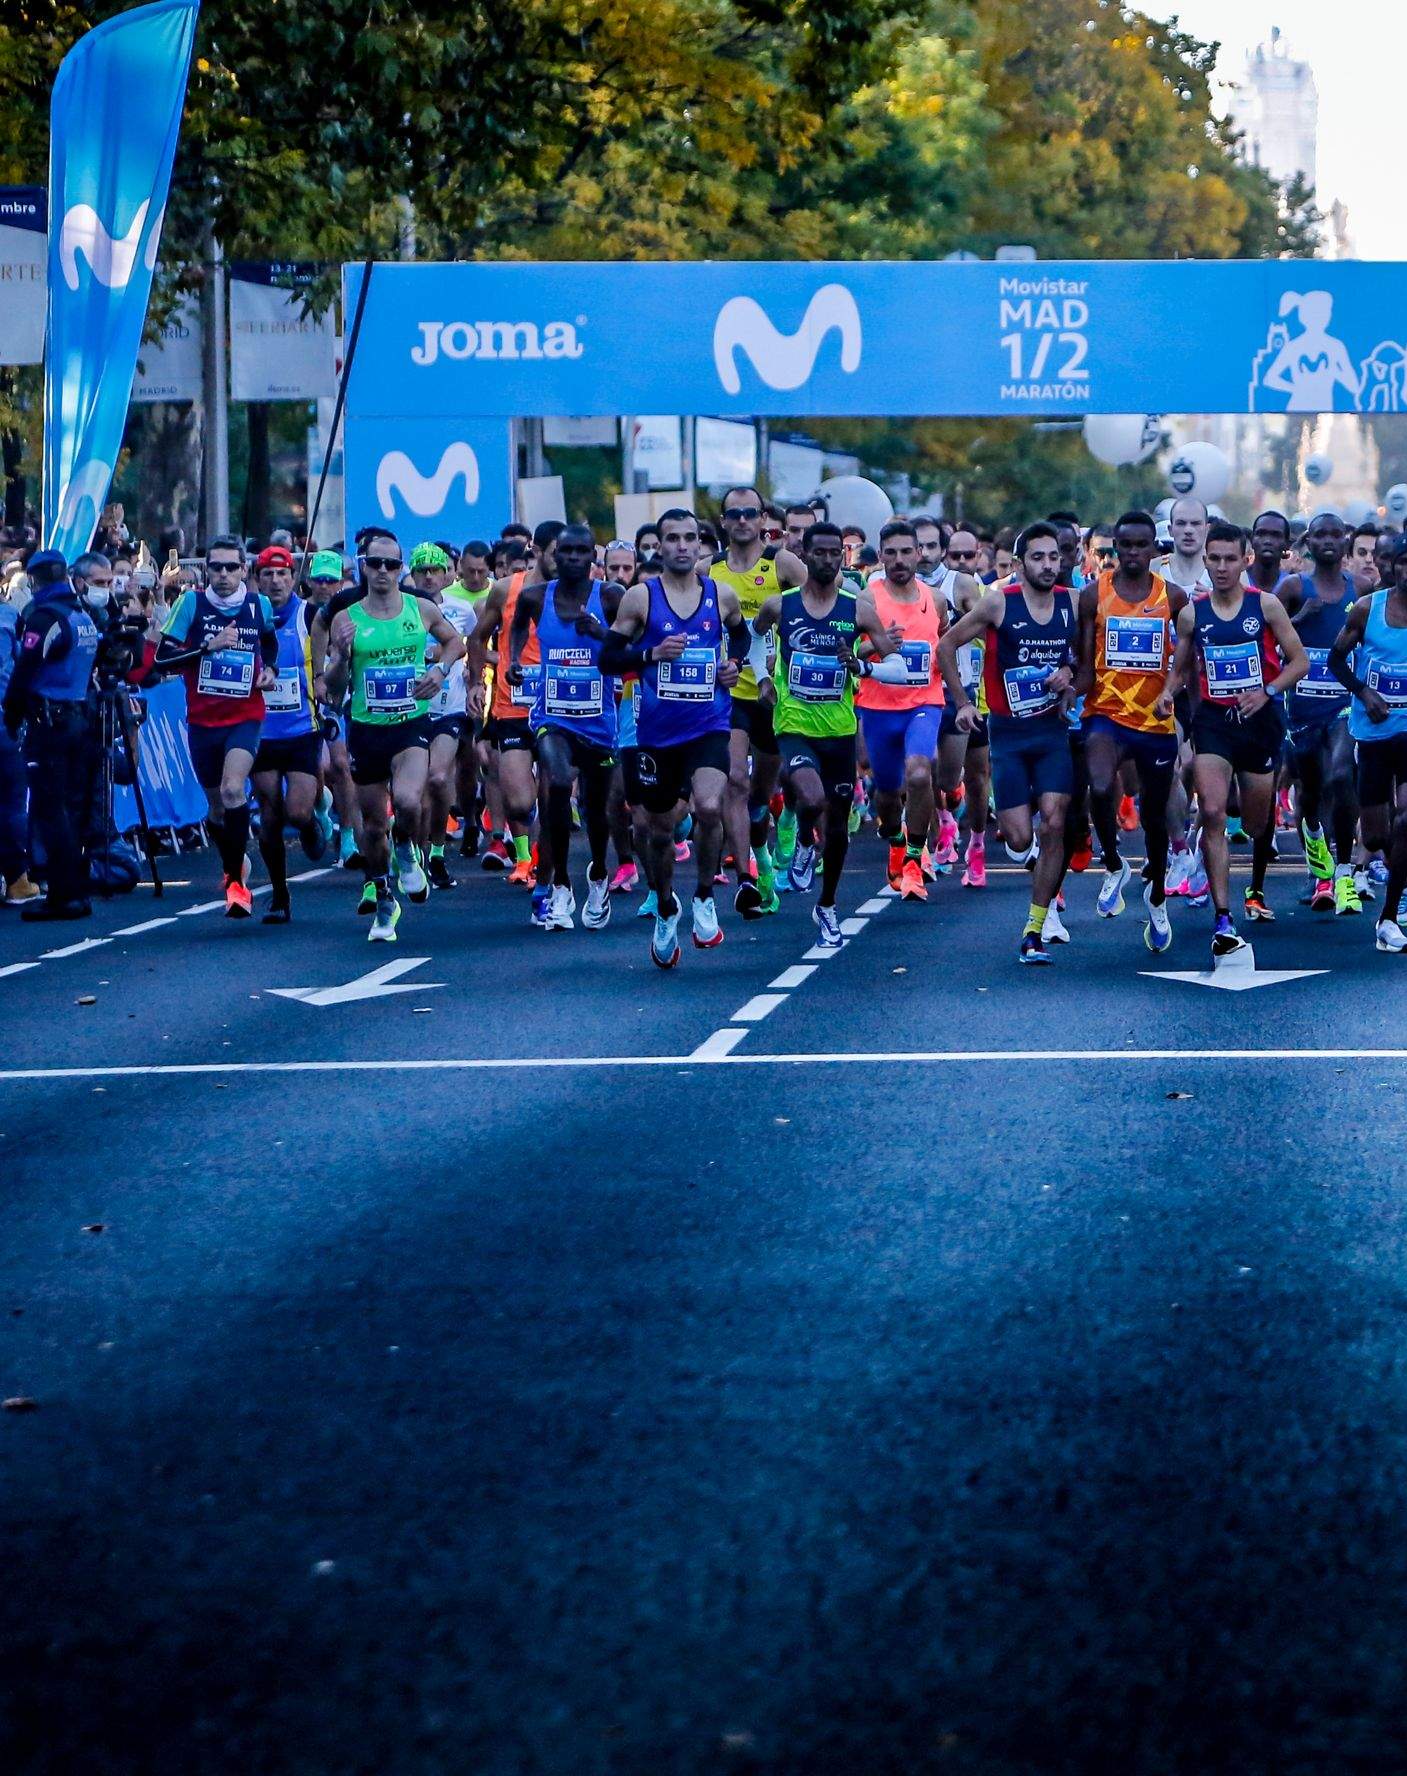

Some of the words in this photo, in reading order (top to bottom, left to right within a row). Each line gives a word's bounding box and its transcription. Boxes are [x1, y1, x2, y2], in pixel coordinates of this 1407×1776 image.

[1001, 278, 1087, 295] Movistar
[1001, 299, 1089, 329] MAD
[1001, 332, 1089, 379] 1/2
[1001, 381, 1089, 399] MARATÓN
[1132, 635, 1139, 646] 2
[221, 665, 232, 676] 74
[680, 667, 698, 677] 158
[1225, 663, 1238, 674] 21
[811, 672, 824, 682] 30
[385, 684, 398, 694] 97
[570, 685, 577, 694] 6
[1030, 682, 1042, 692] 51
[1389, 681, 1400, 690] 13
